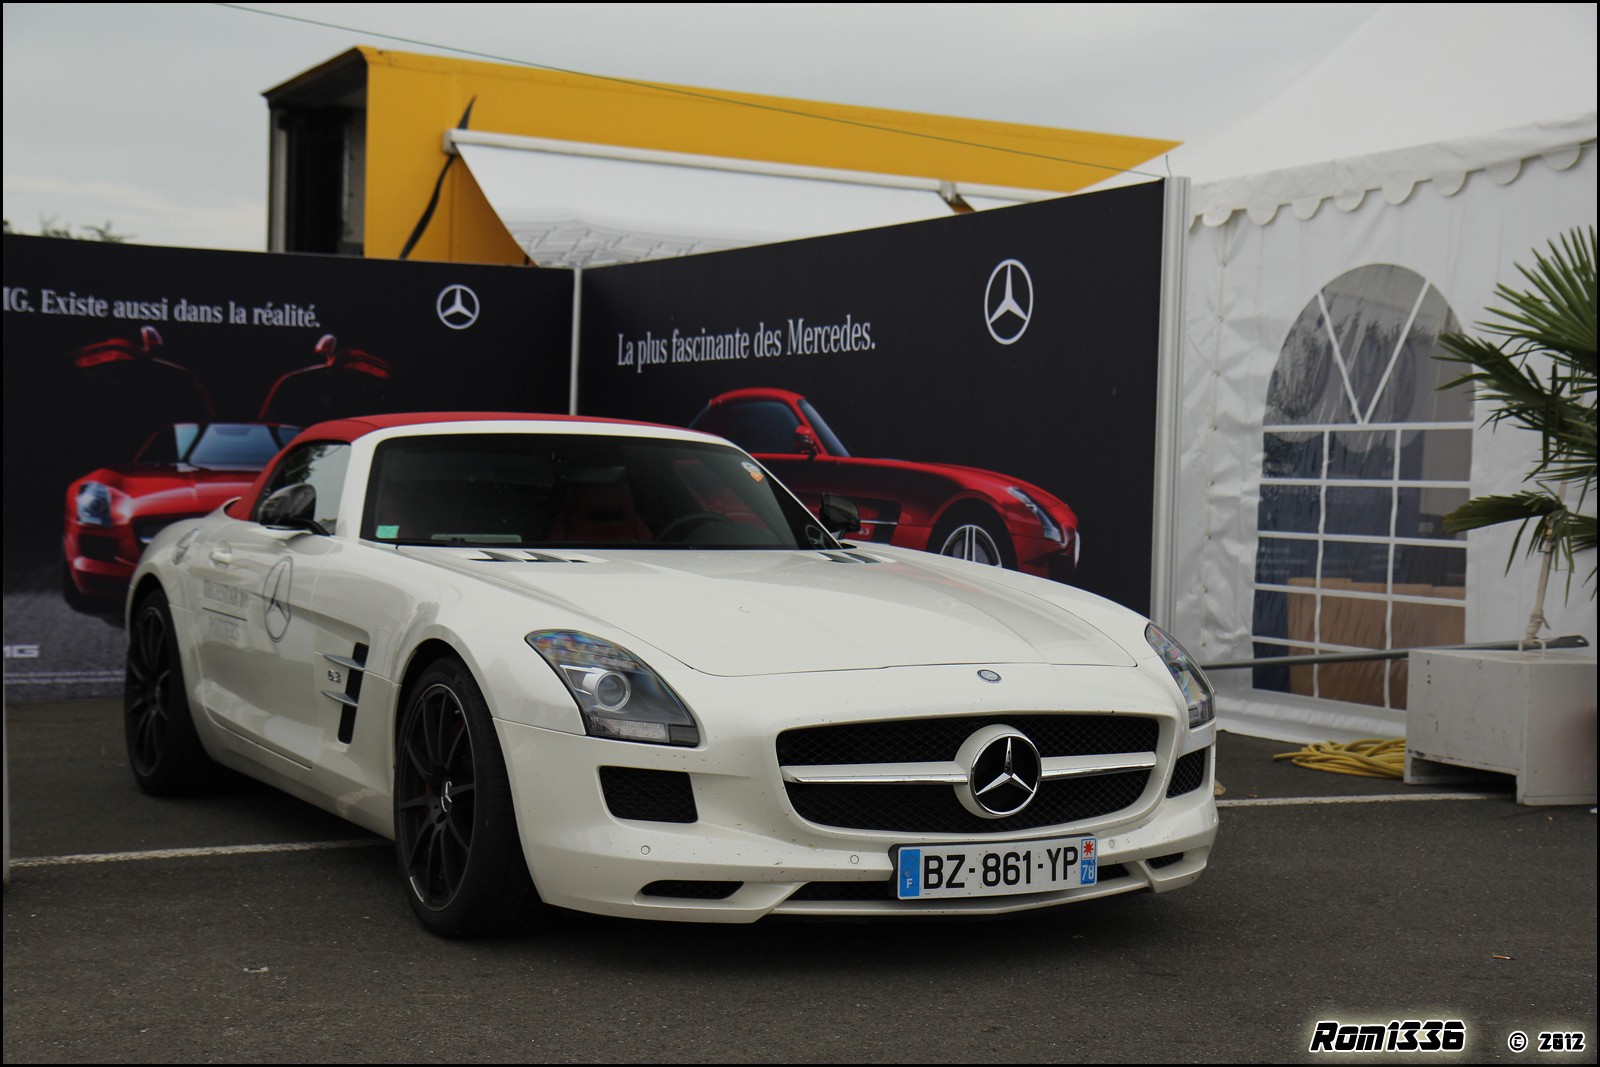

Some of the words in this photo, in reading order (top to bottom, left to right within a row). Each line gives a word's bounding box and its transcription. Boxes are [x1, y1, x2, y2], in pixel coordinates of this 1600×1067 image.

[40, 289, 109, 318] Existe
[112, 298, 169, 321] aussi
[173, 298, 224, 323] dans
[228, 300, 247, 324] la
[252, 301, 321, 327] réalité.
[617, 333, 634, 366] La
[637, 331, 668, 373] plus
[671, 327, 750, 363] fascinante
[753, 322, 782, 358] des
[786, 314, 876, 356] Mercedes.
[906, 878, 913, 889] F
[923, 846, 1079, 890] BZ-861-YP
[1082, 864, 1094, 881] 78
